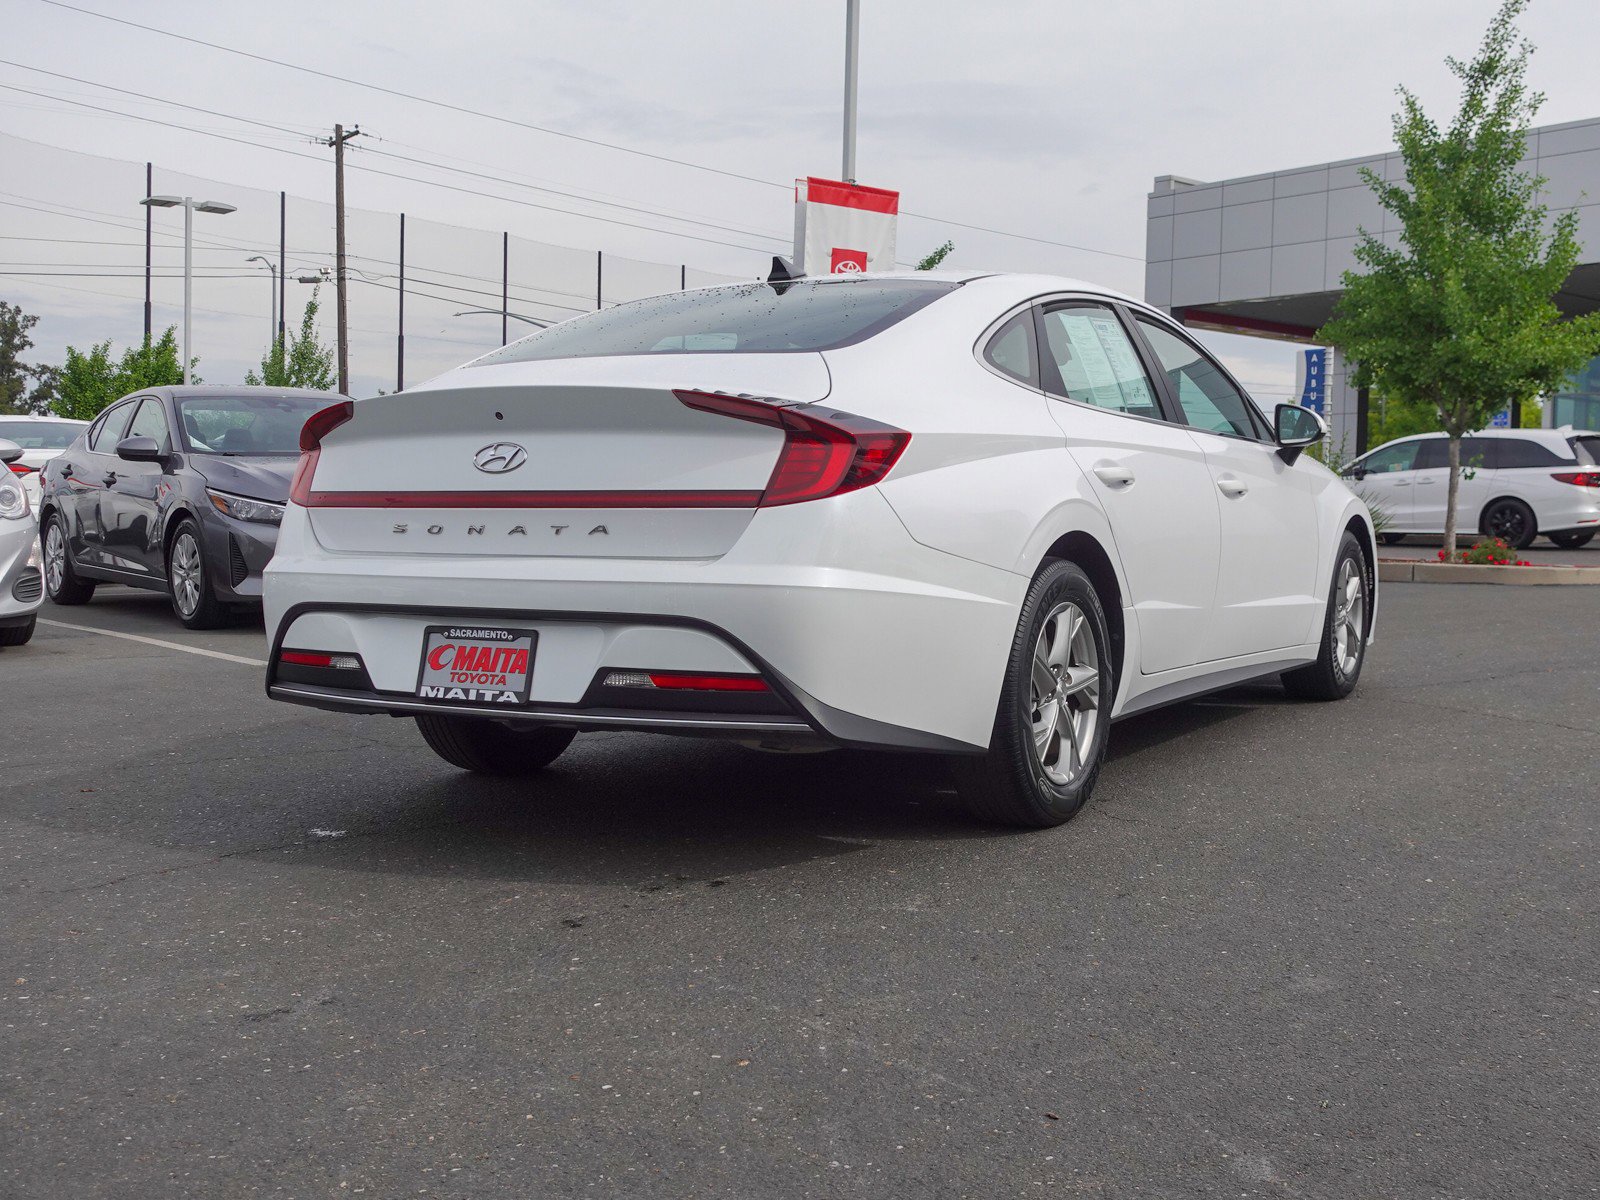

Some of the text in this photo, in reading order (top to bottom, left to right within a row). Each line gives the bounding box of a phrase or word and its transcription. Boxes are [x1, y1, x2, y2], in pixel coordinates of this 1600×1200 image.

[392, 523, 609, 536] SONATA
[450, 628, 508, 639] SACRAMENTO
[449, 672, 507, 686] TOYOTA
[419, 685, 520, 704] MAITA
